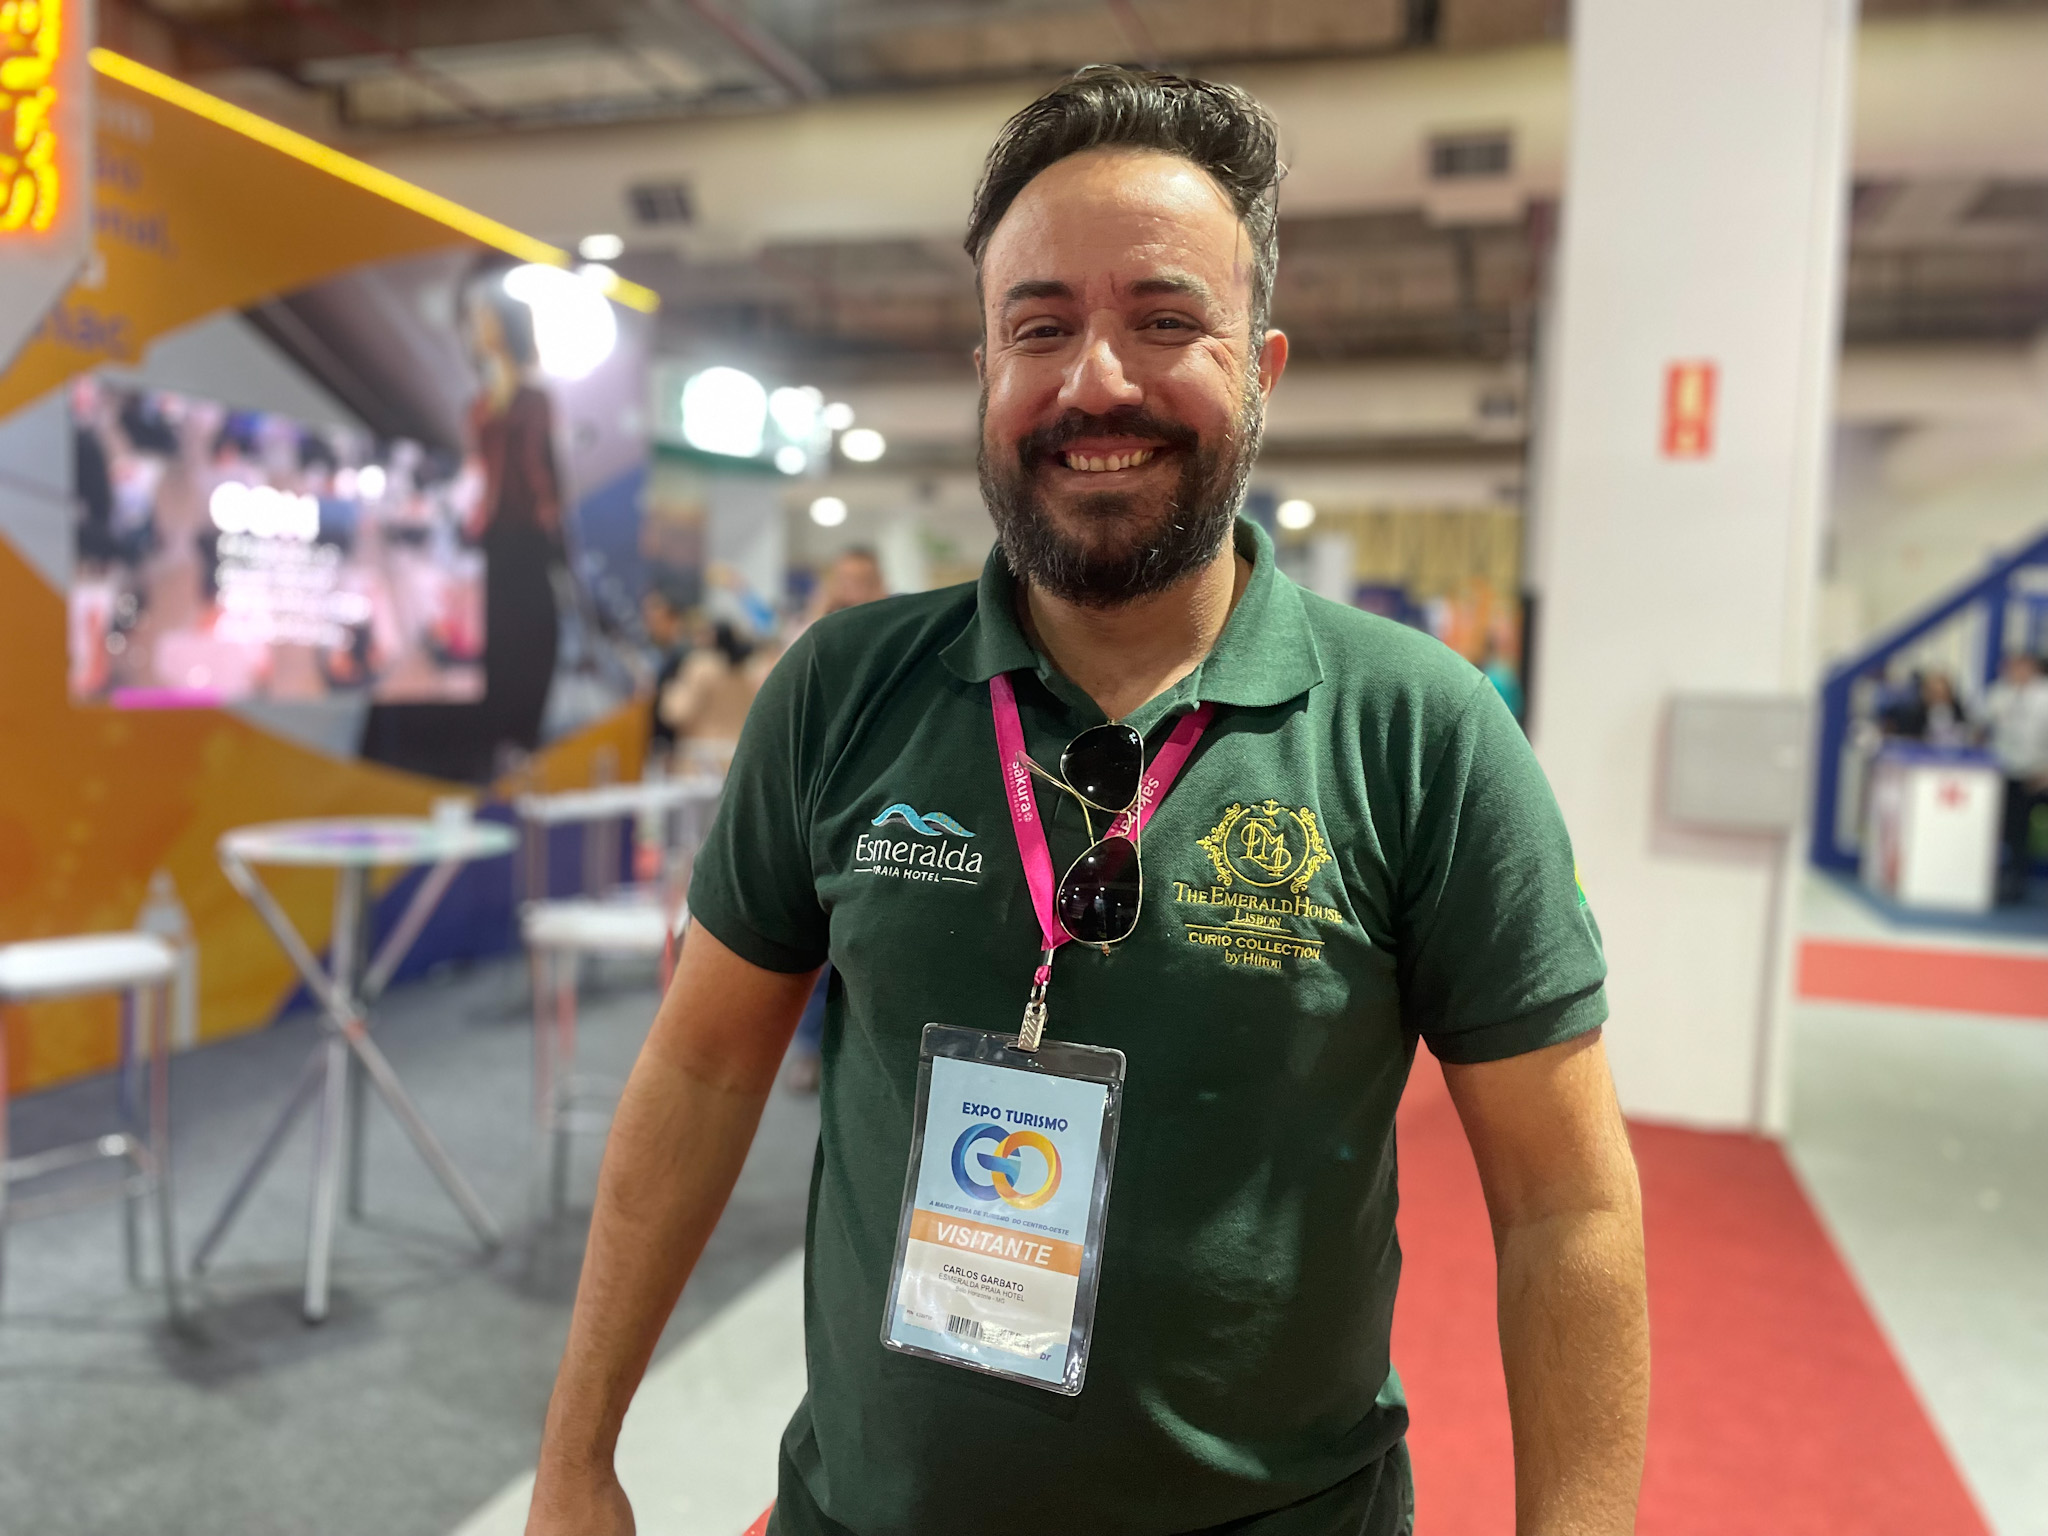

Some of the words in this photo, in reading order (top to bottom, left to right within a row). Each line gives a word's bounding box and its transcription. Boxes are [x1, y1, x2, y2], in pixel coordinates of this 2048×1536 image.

[1012, 761, 1031, 813] sakura
[856, 834, 983, 873] Esmeralda
[903, 869, 940, 882] HOTEL
[1173, 881, 1208, 904] THE
[1210, 886, 1293, 914] EMERALD
[1294, 895, 1343, 923] HOUSE
[1233, 908, 1282, 928] LISBON
[1188, 931, 1232, 947] CURIO
[1235, 937, 1320, 960] COLLECTION
[1225, 949, 1240, 965] by
[1243, 951, 1282, 969] Hilton
[962, 1101, 1002, 1120] EXPO
[1005, 1109, 1069, 1132] TURISMO
[935, 1201, 954, 1210] MAIOR
[954, 1205, 972, 1214] FEIRA
[983, 1211, 1010, 1222] TURISMO
[1022, 1220, 1070, 1236] CENTRO-OESTE
[937, 1222, 1053, 1265] VISITANTE
[938, 1272, 979, 1289] ESMERALDA
[980, 1283, 1000, 1294] PRAIA
[1002, 1290, 1025, 1302] HOTEL
[943, 1264, 979, 1281] CARLOS
[980, 1274, 1024, 1292] GARBATO
